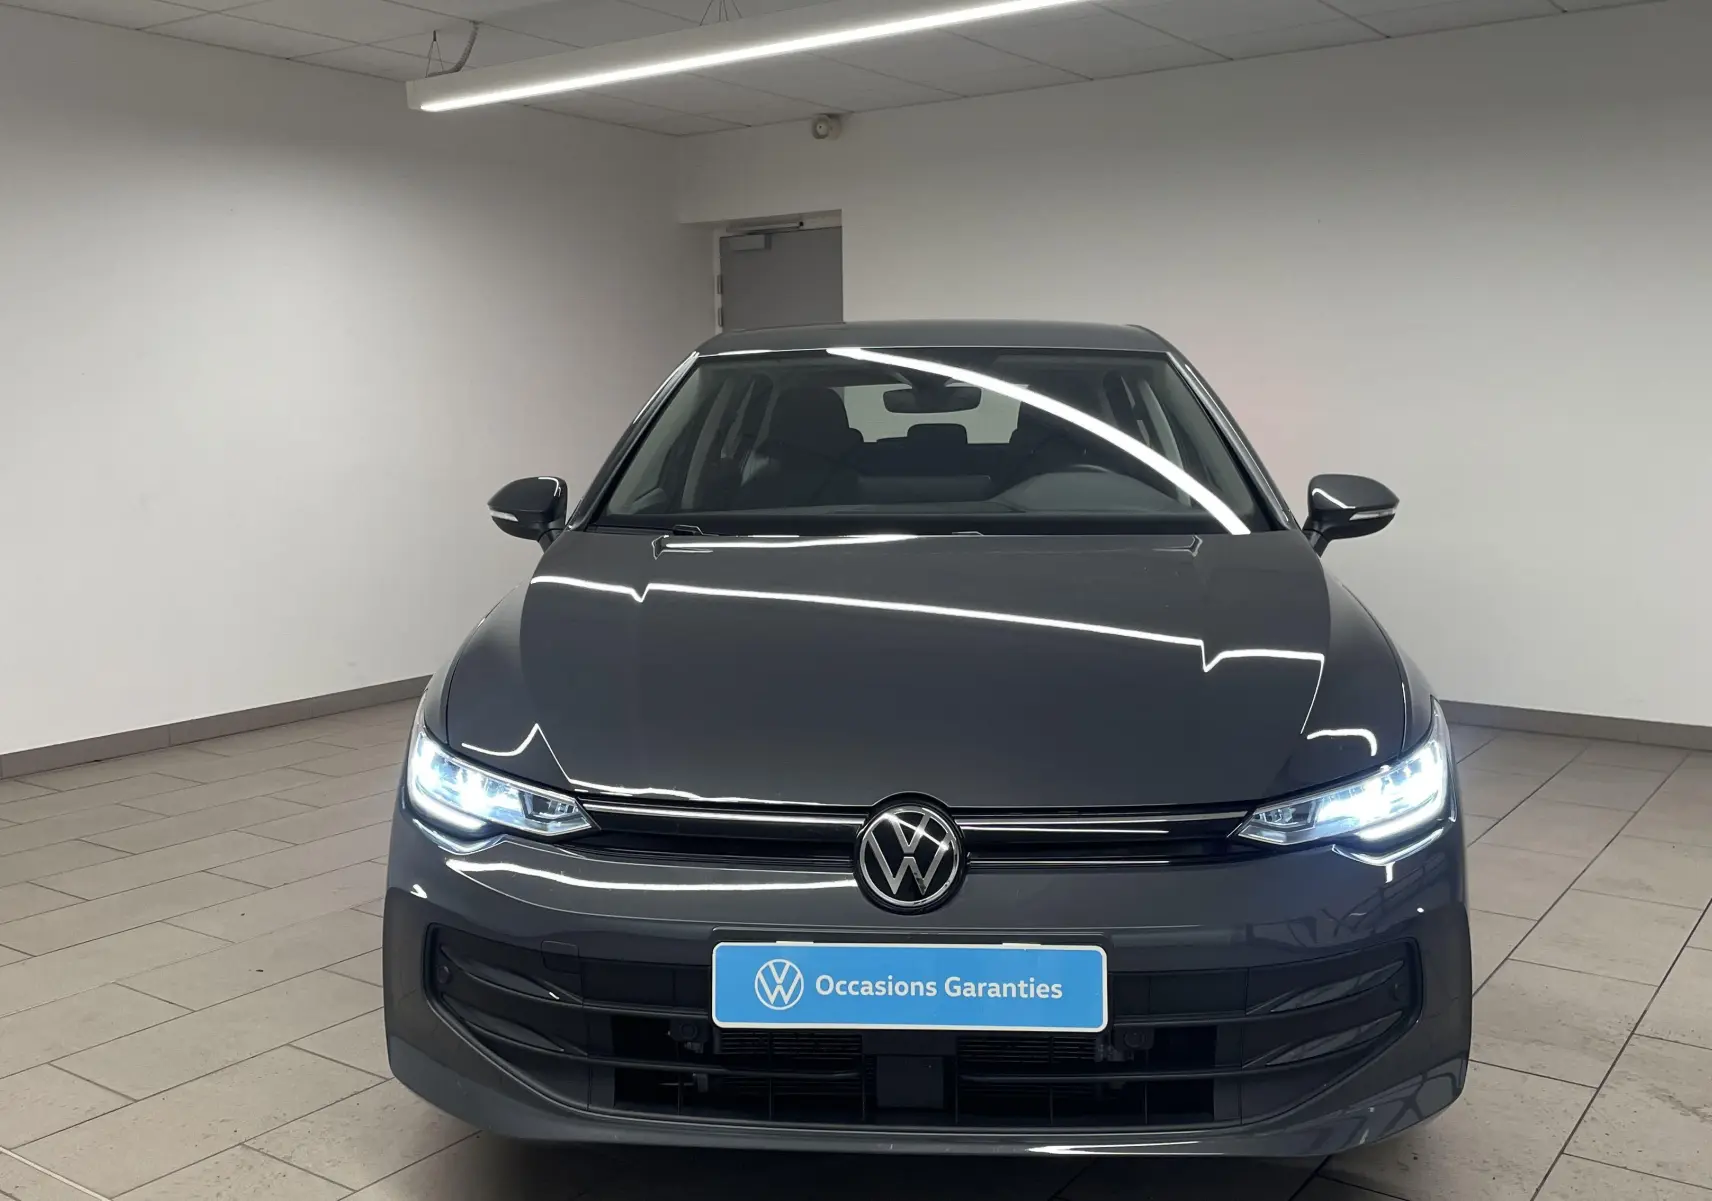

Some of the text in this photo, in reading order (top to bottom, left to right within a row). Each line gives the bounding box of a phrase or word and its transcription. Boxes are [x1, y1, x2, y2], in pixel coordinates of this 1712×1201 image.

[865, 809, 952, 896] VW
[756, 960, 1063, 1009] VW Occasions Garanties
